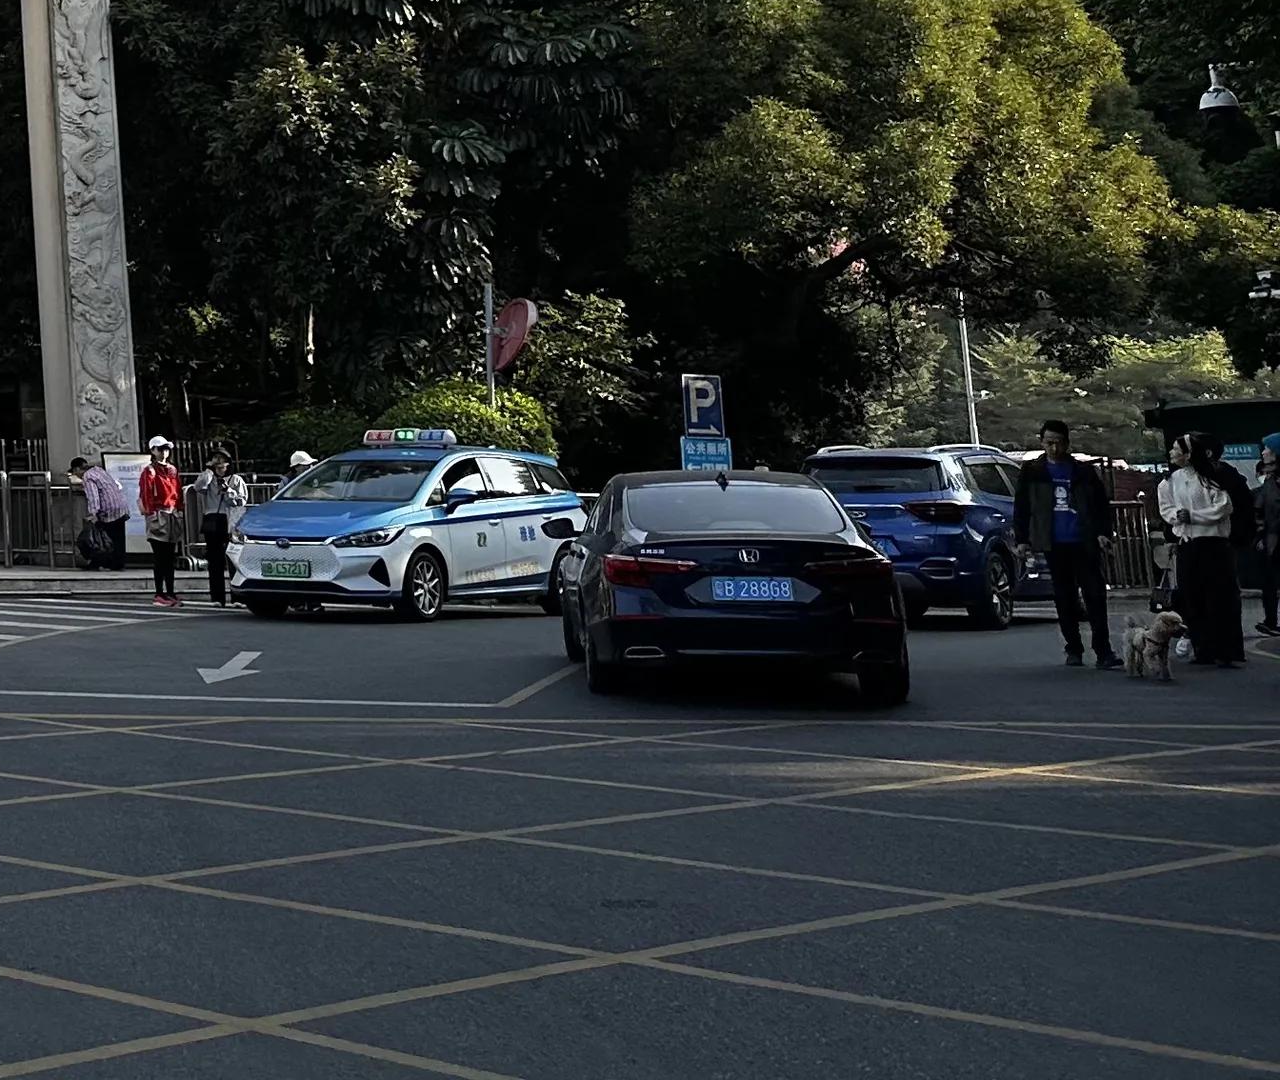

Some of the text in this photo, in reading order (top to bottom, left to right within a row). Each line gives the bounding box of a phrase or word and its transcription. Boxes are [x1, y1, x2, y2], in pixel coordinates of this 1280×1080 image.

[688, 380, 716, 423] P
[685, 442, 728, 456] 公共厕所
